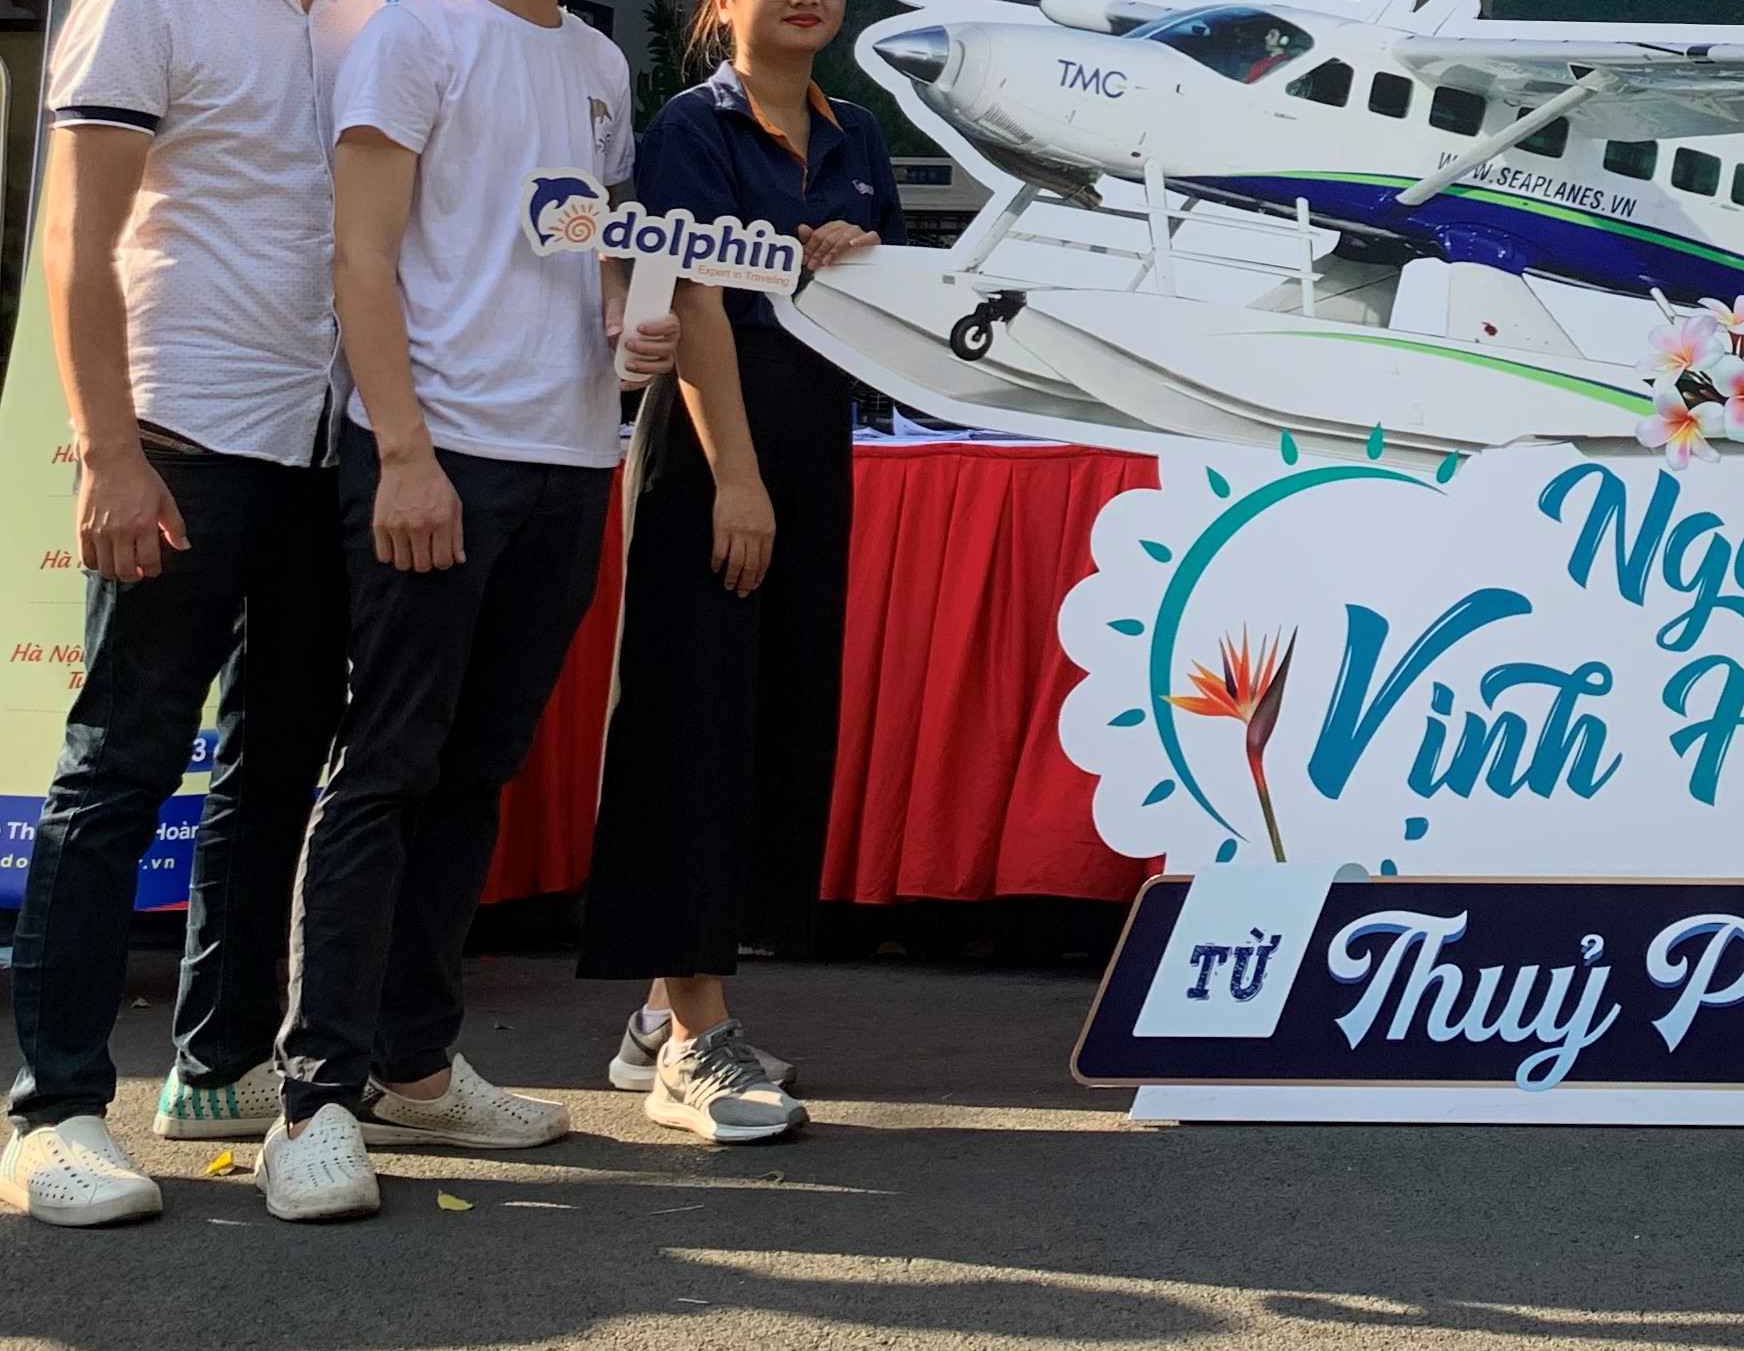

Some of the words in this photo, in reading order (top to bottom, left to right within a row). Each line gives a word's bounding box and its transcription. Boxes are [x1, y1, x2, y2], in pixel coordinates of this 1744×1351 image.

[602, 211, 795, 272] dolphin
[698, 264, 731, 280] Expert
[732, 269, 743, 279] in
[744, 271, 790, 288] Traveling
[10, 642, 43, 663] Hà
[1309, 587, 1622, 842] Vịnh
[1188, 927, 1284, 1004] TỪ
[1328, 909, 1623, 1091] Thuỷ
